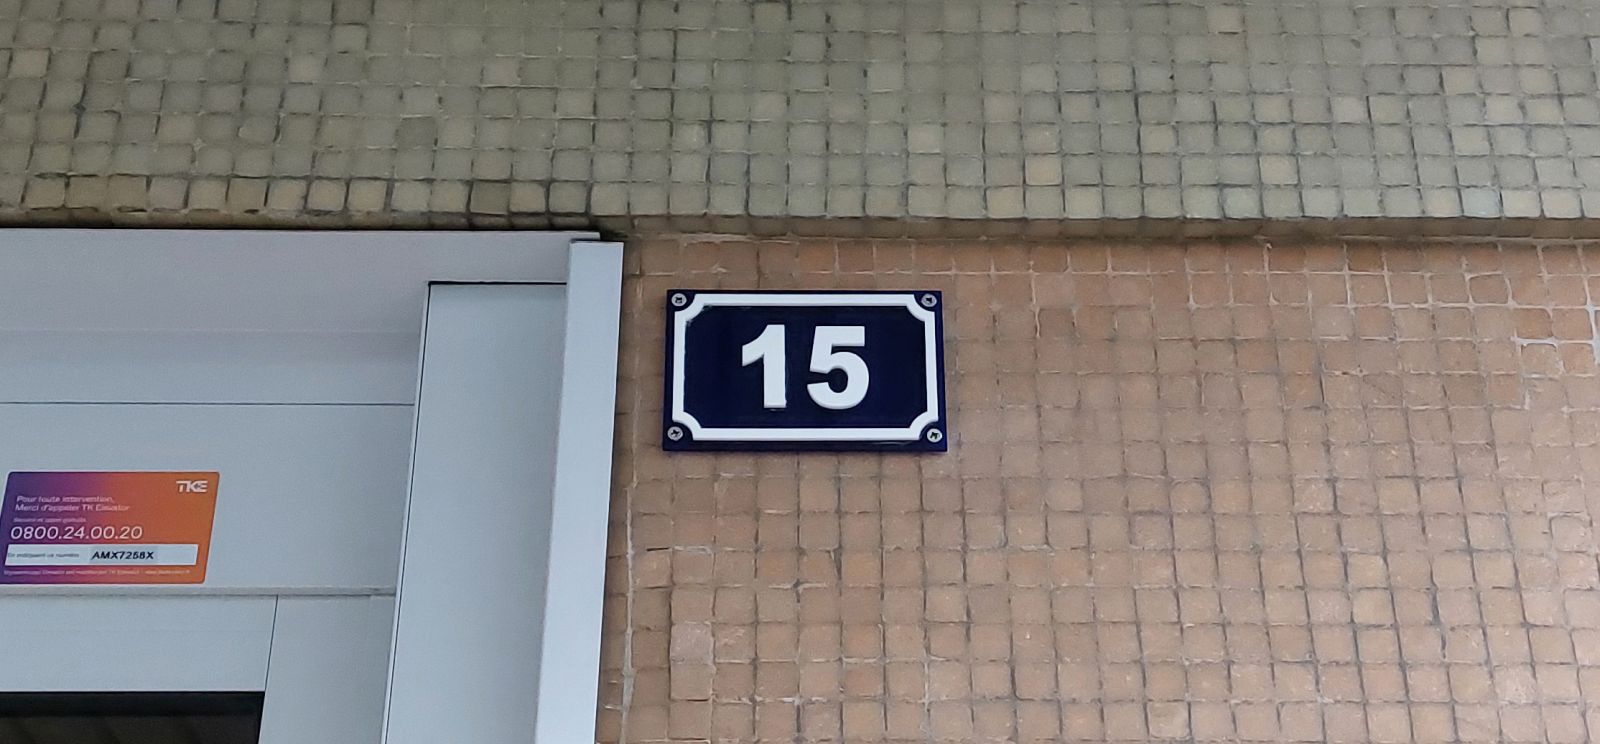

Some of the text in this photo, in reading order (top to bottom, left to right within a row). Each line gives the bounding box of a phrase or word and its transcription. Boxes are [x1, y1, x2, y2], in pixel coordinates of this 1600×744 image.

[742, 324, 869, 410] 15
[176, 480, 208, 493] TKE
[16, 495, 37, 503] Pour
[39, 495, 60, 503] toute
[10, 525, 143, 540] 0800.24.00.20
